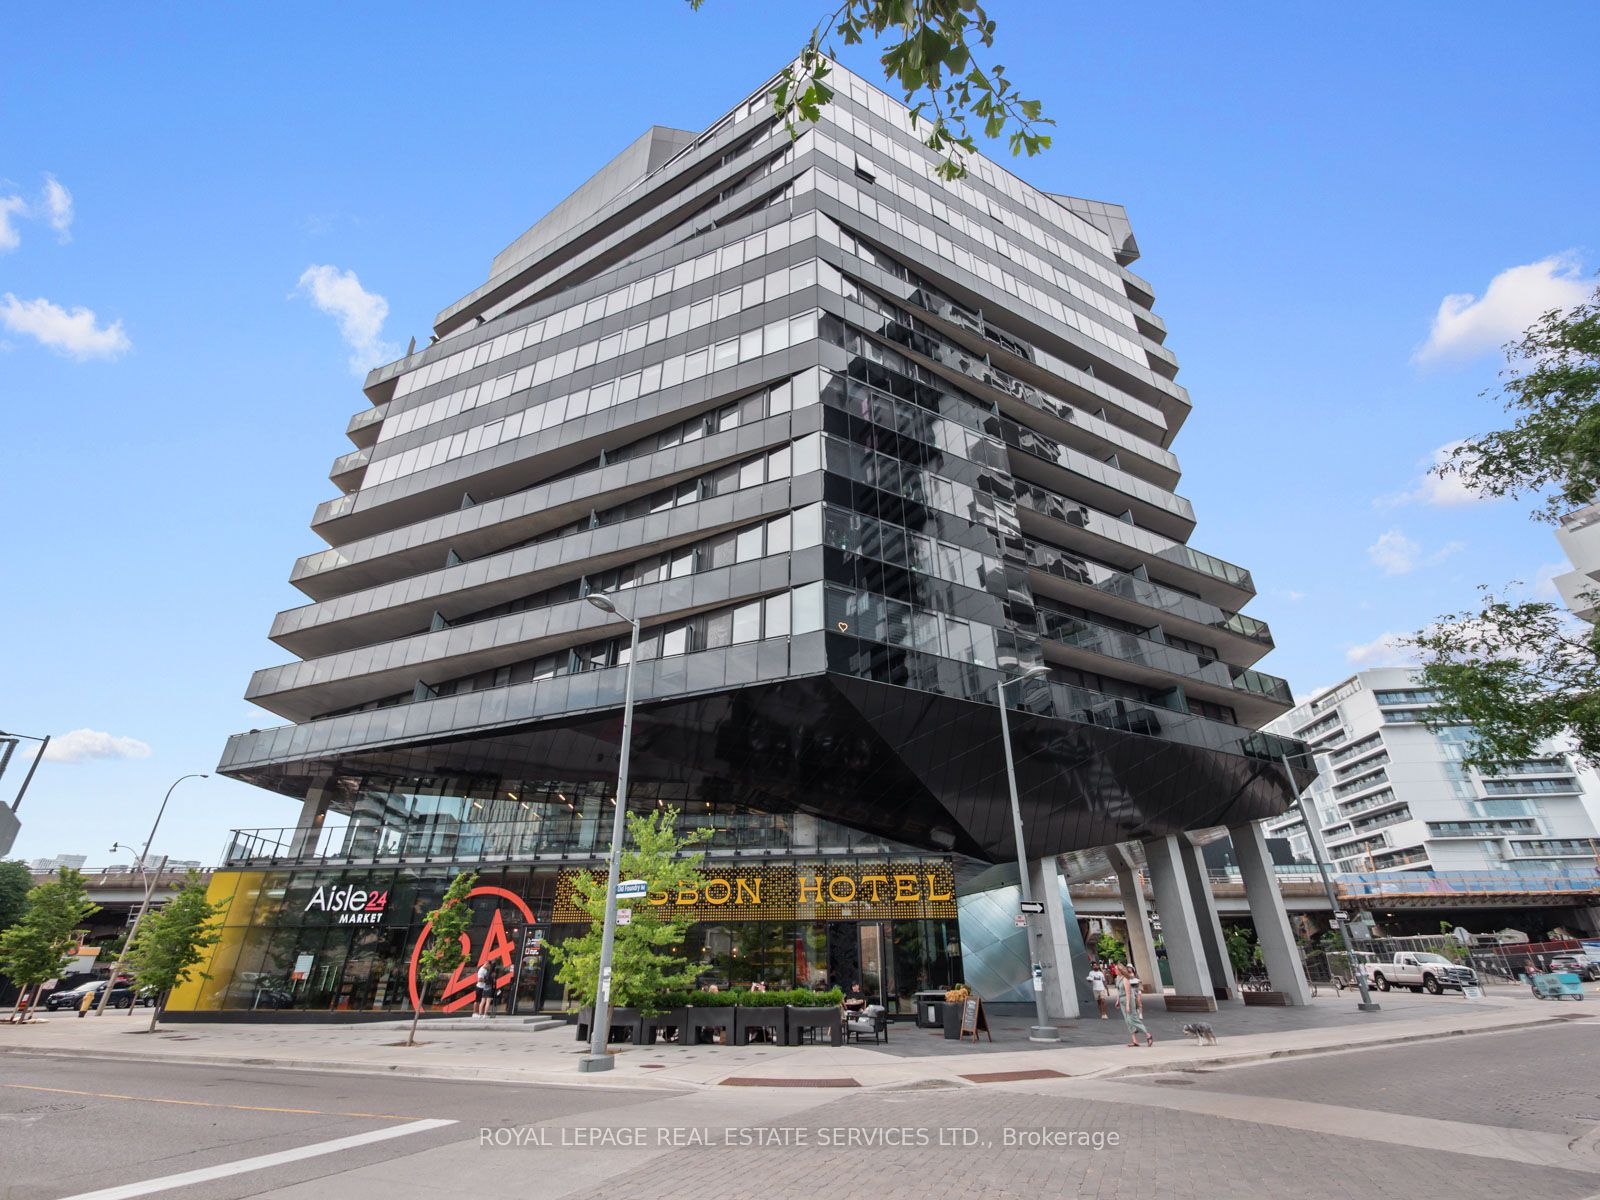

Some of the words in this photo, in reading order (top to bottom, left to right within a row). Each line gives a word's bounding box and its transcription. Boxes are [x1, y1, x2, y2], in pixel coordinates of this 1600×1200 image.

[590, 878, 761, 905] SBON
[799, 874, 951, 903] HOTEL
[339, 913, 383, 924] MARKET
